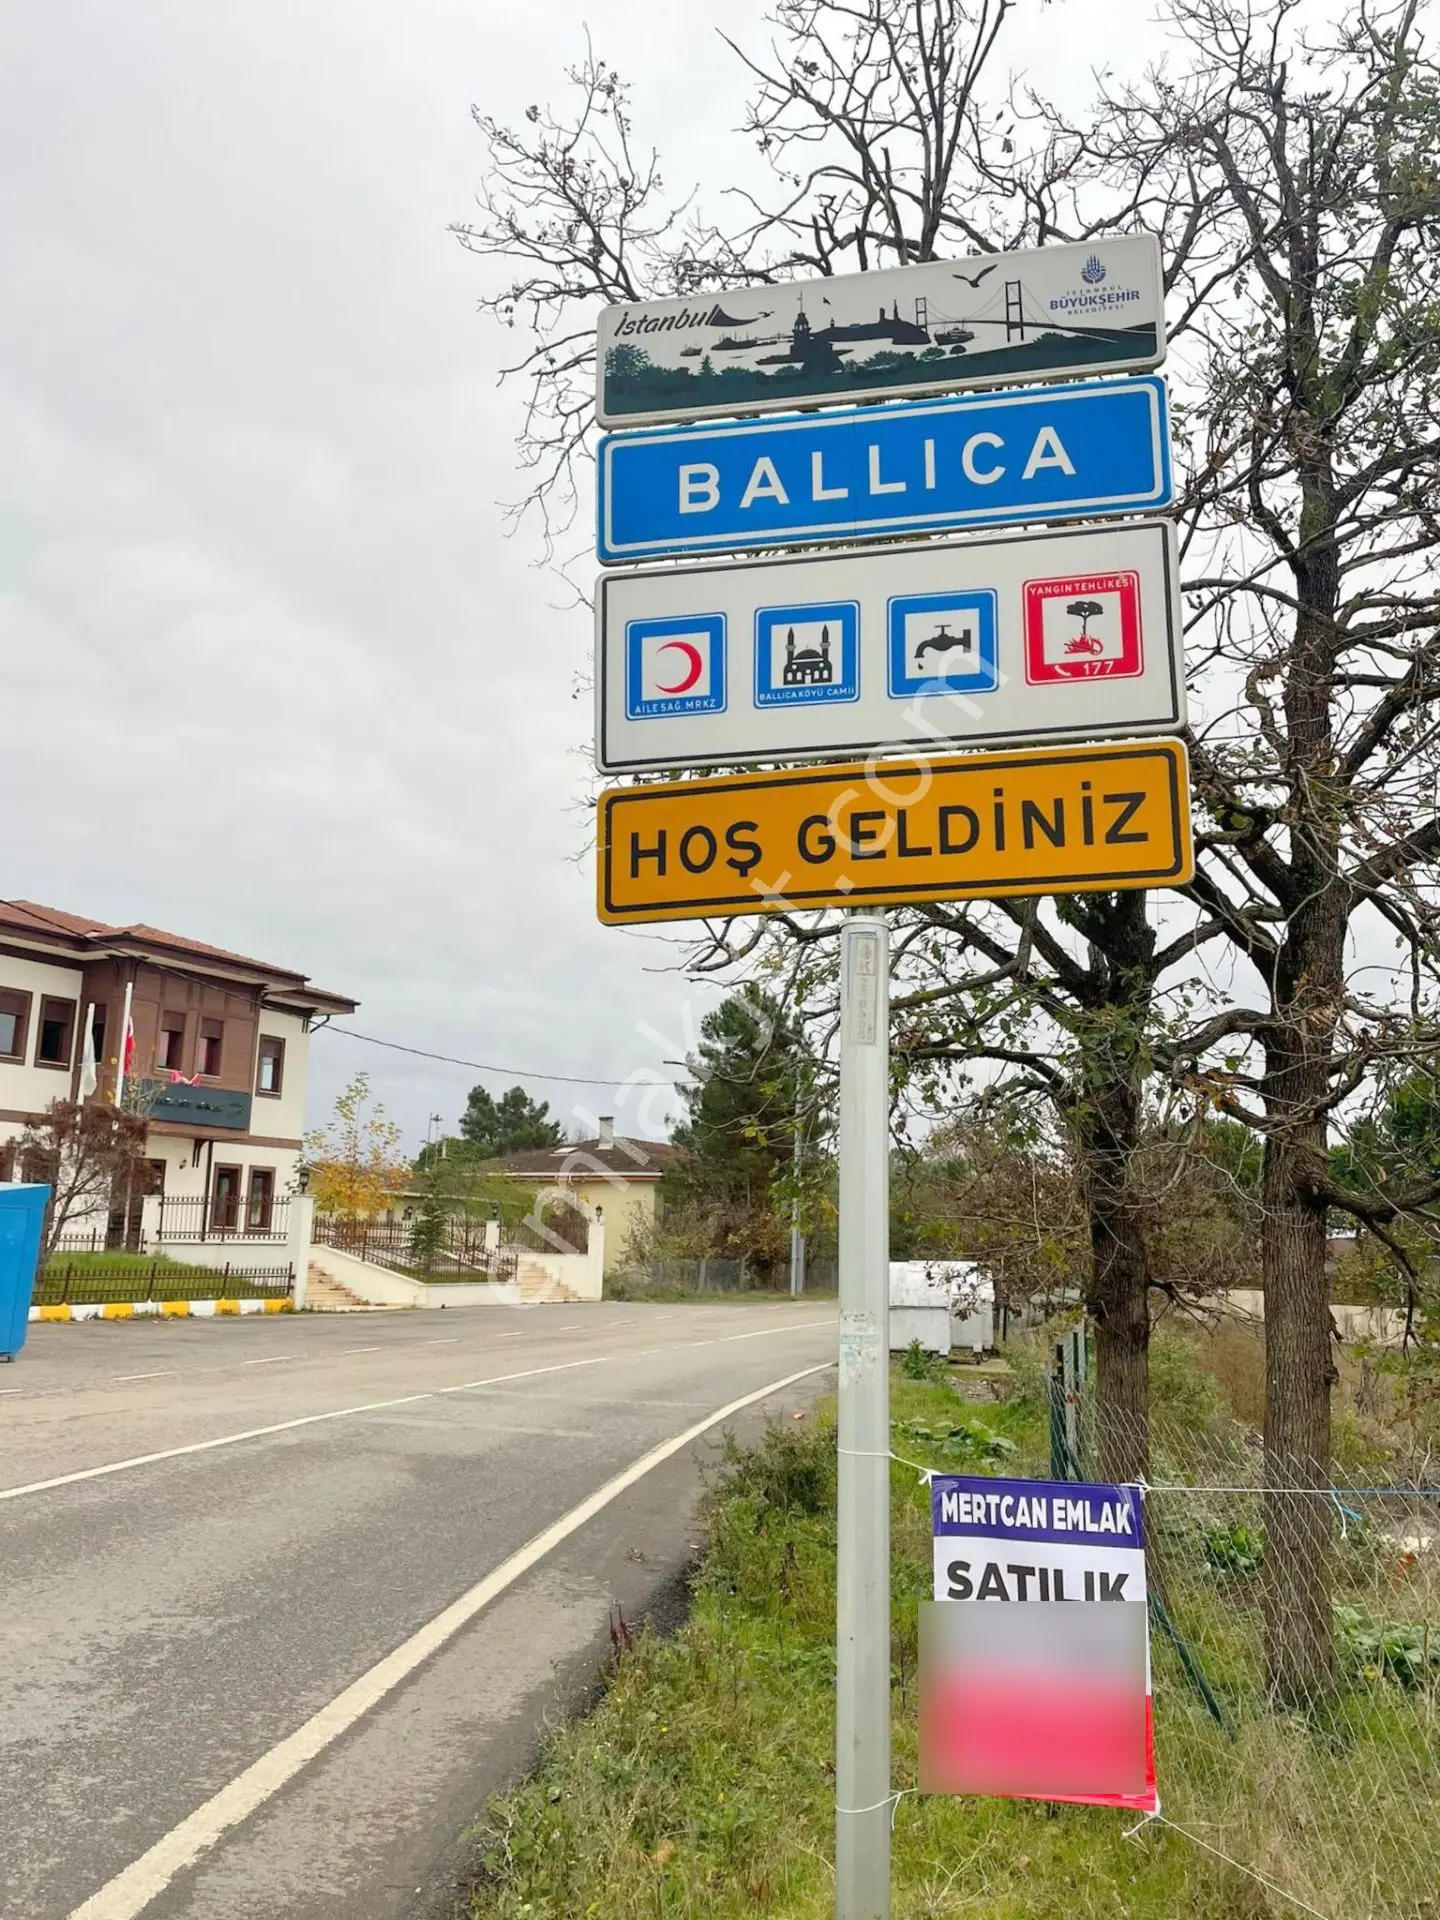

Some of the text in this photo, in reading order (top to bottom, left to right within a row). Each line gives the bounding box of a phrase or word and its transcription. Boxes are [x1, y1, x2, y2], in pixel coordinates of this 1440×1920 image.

[678, 426, 1076, 514] BALLICA
[1029, 584, 1072, 596] YANGIN
[1083, 660, 1115, 675] 177
[635, 703, 659, 714] AİLE
[685, 699, 716, 709] MRKZ
[631, 780, 1148, 878] HOŞ GELDİNİZ
[941, 1492, 1132, 1535] MERTCAN EMLAK
[947, 1560, 1129, 1602] SATILIK
